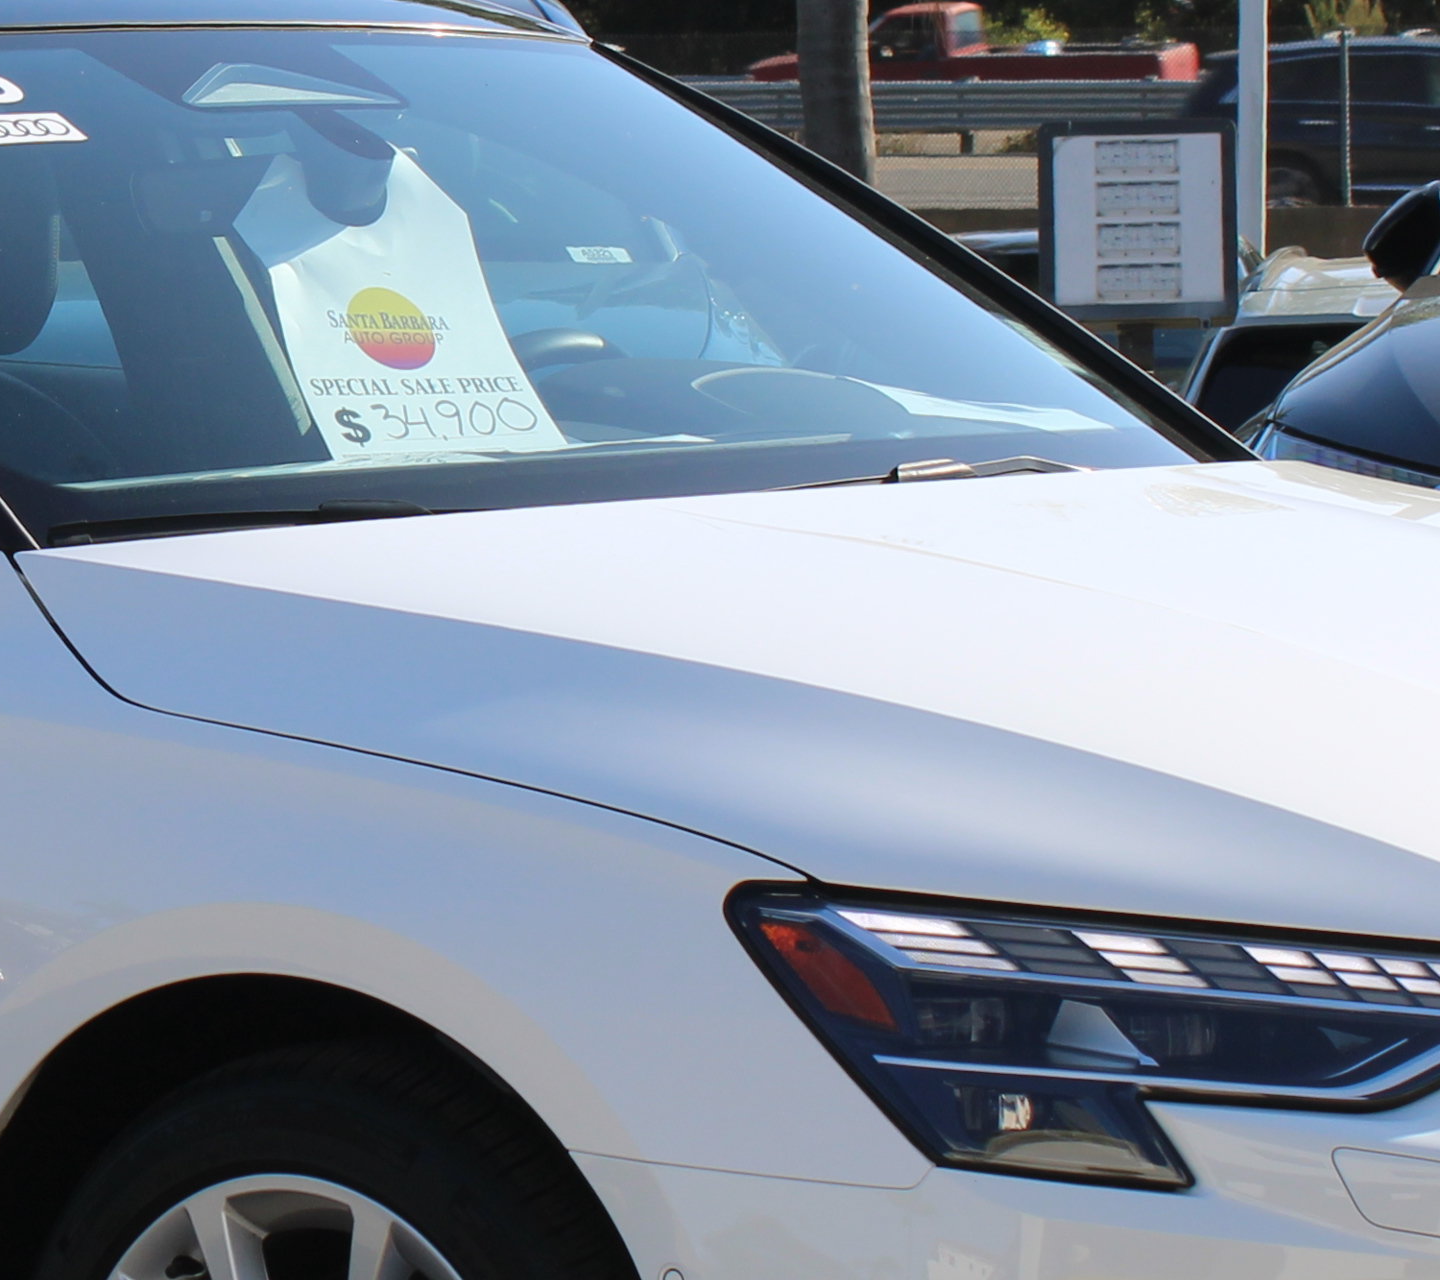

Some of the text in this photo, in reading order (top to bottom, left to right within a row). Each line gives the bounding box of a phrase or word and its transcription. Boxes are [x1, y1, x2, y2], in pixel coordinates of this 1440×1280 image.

[326, 309, 451, 332] SANTA BARBARA
[343, 330, 445, 346] AUTO GROUP
[309, 375, 524, 397] SPECIAL SALE PRICE
